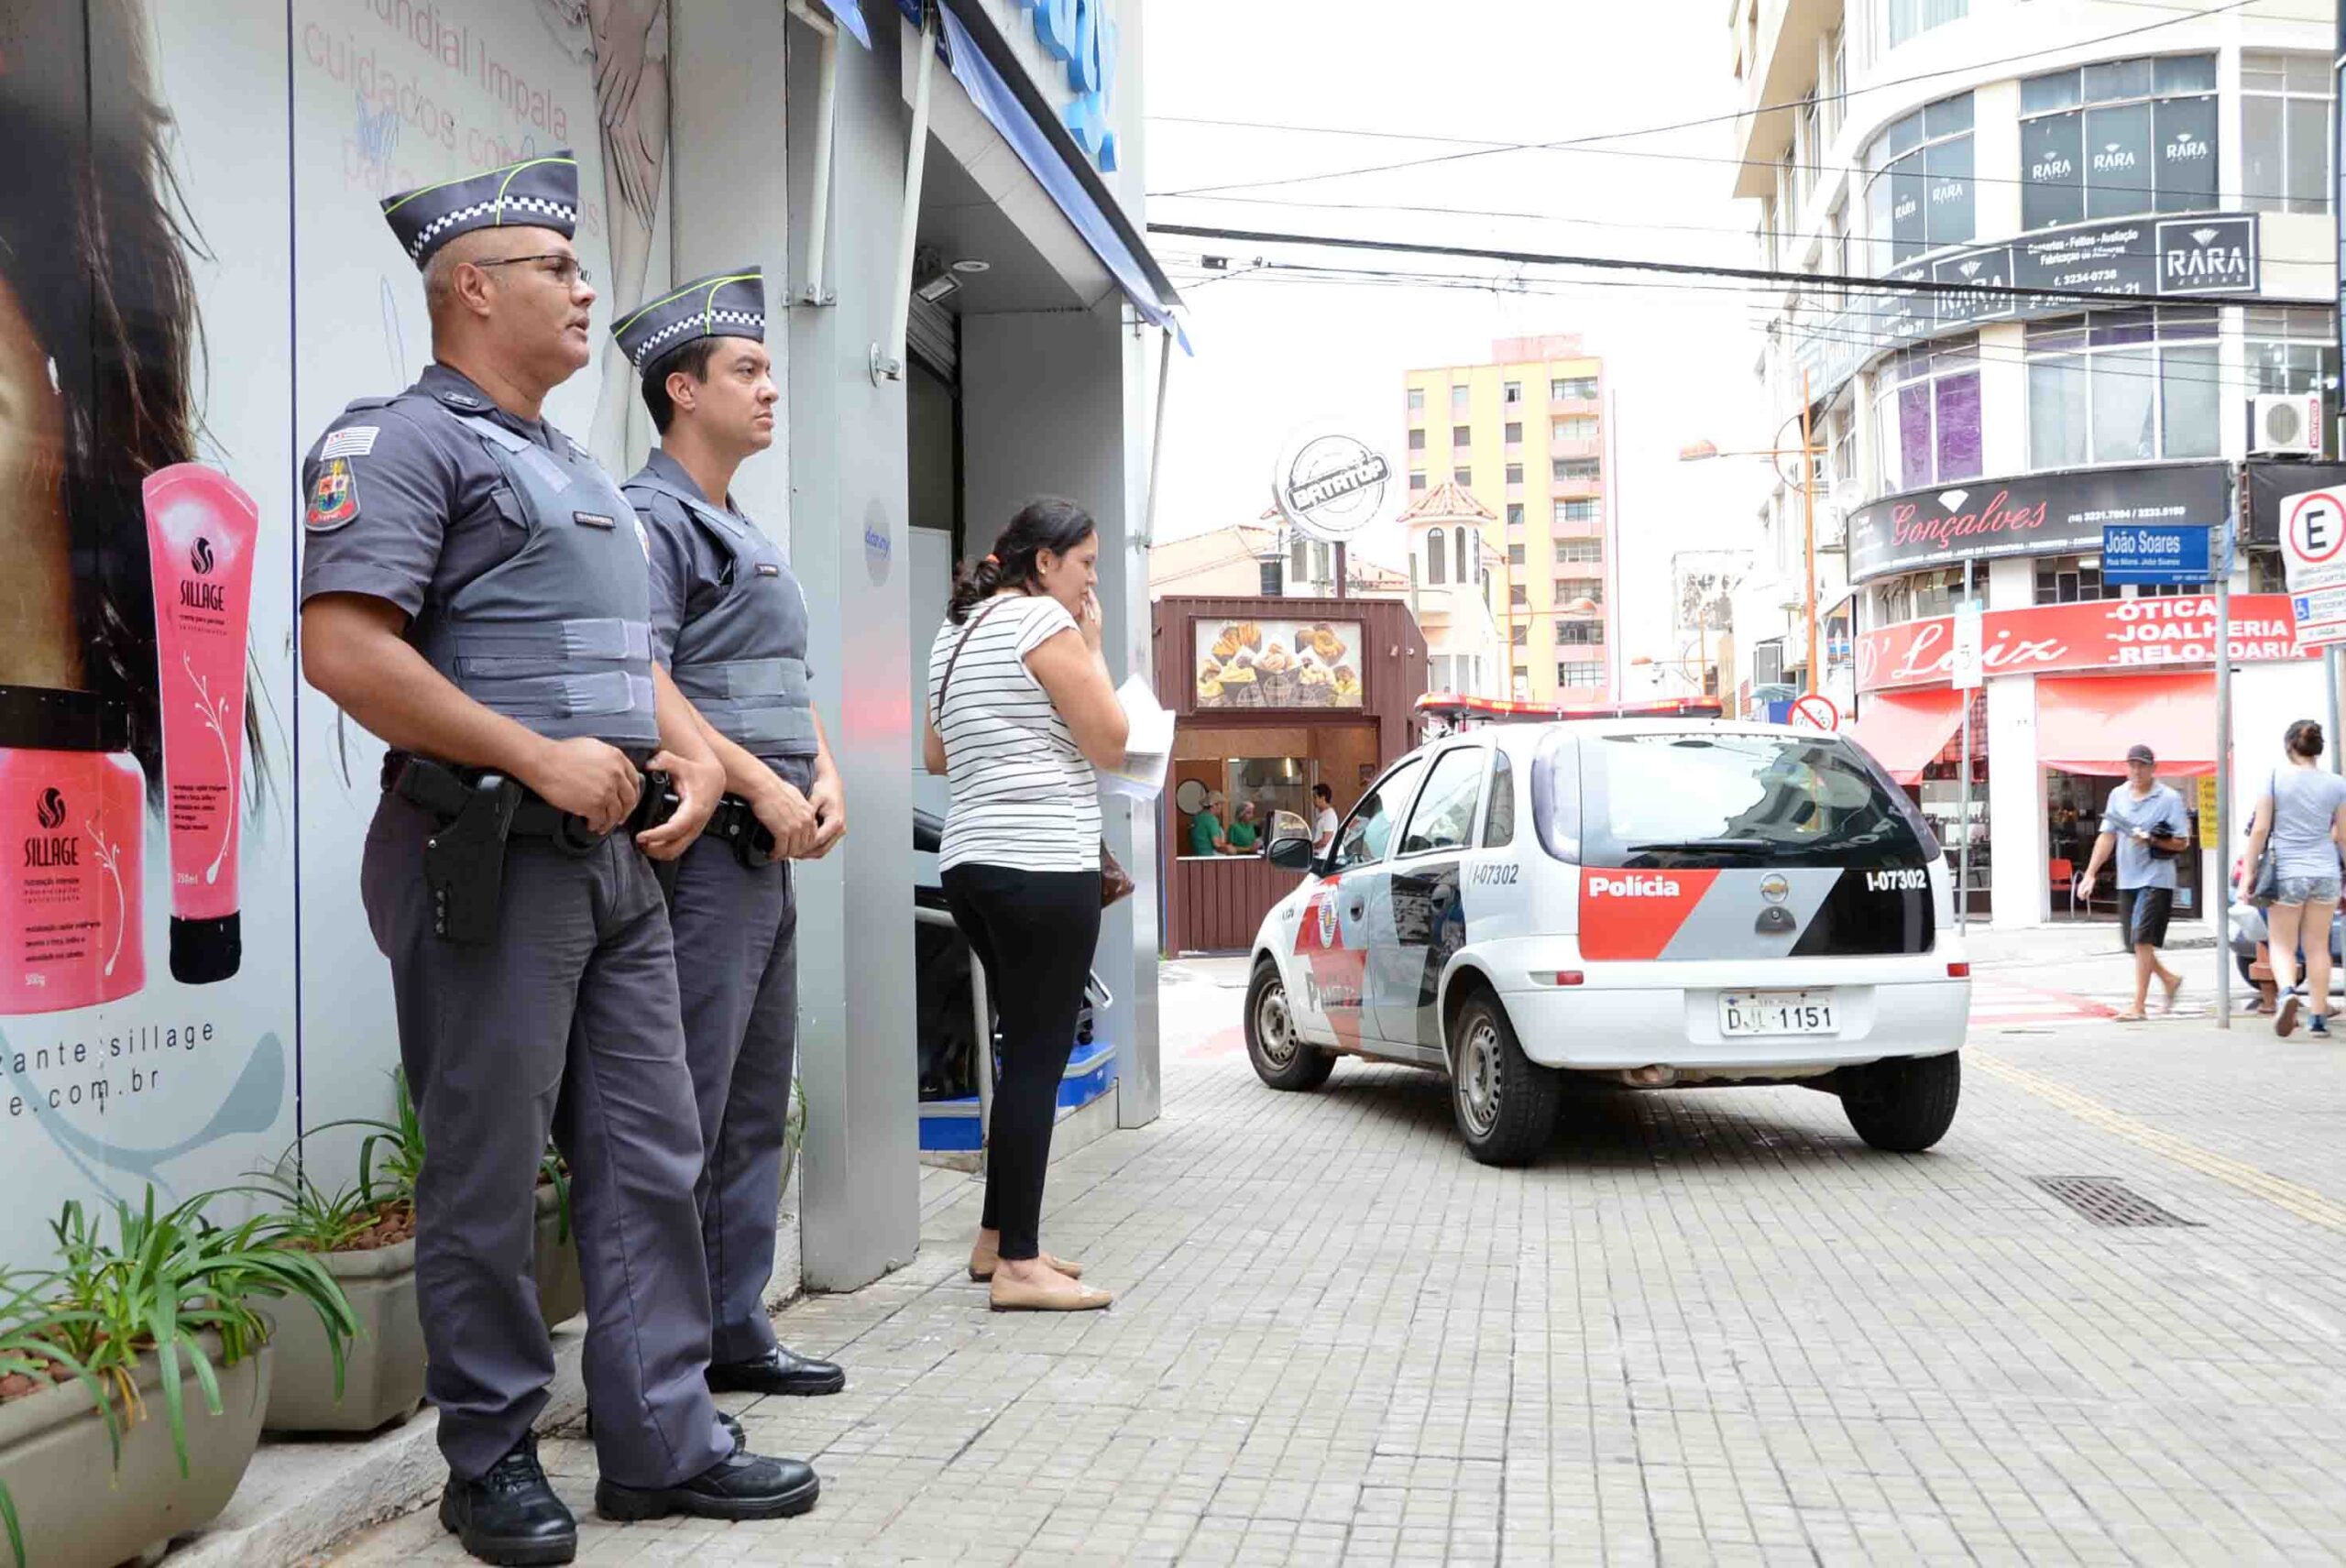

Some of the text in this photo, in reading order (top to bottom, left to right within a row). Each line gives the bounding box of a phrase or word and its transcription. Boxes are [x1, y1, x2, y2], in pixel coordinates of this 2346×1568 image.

[304, 22, 457, 151] cuidados
[367, 0, 567, 146] undial Impala
[2094, 152, 2136, 170] RARA
[2166, 141, 2208, 159] RARA
[2033, 159, 2072, 180] RARA
[1933, 183, 1963, 202] RARA
[2168, 247, 2246, 277] RARA
[1291, 458, 1385, 510] BATATOP
[1891, 490, 2047, 549] Gonçalves
[2307, 510, 2327, 550] E
[2106, 529, 2181, 554] João Soares
[180, 579, 225, 612] SILLAGE
[25, 837, 80, 867] SILLAGE
[1589, 874, 1681, 898] Polícia
[1780, 1006, 1831, 1028] 1151
[110, 1022, 214, 1057] sillage
